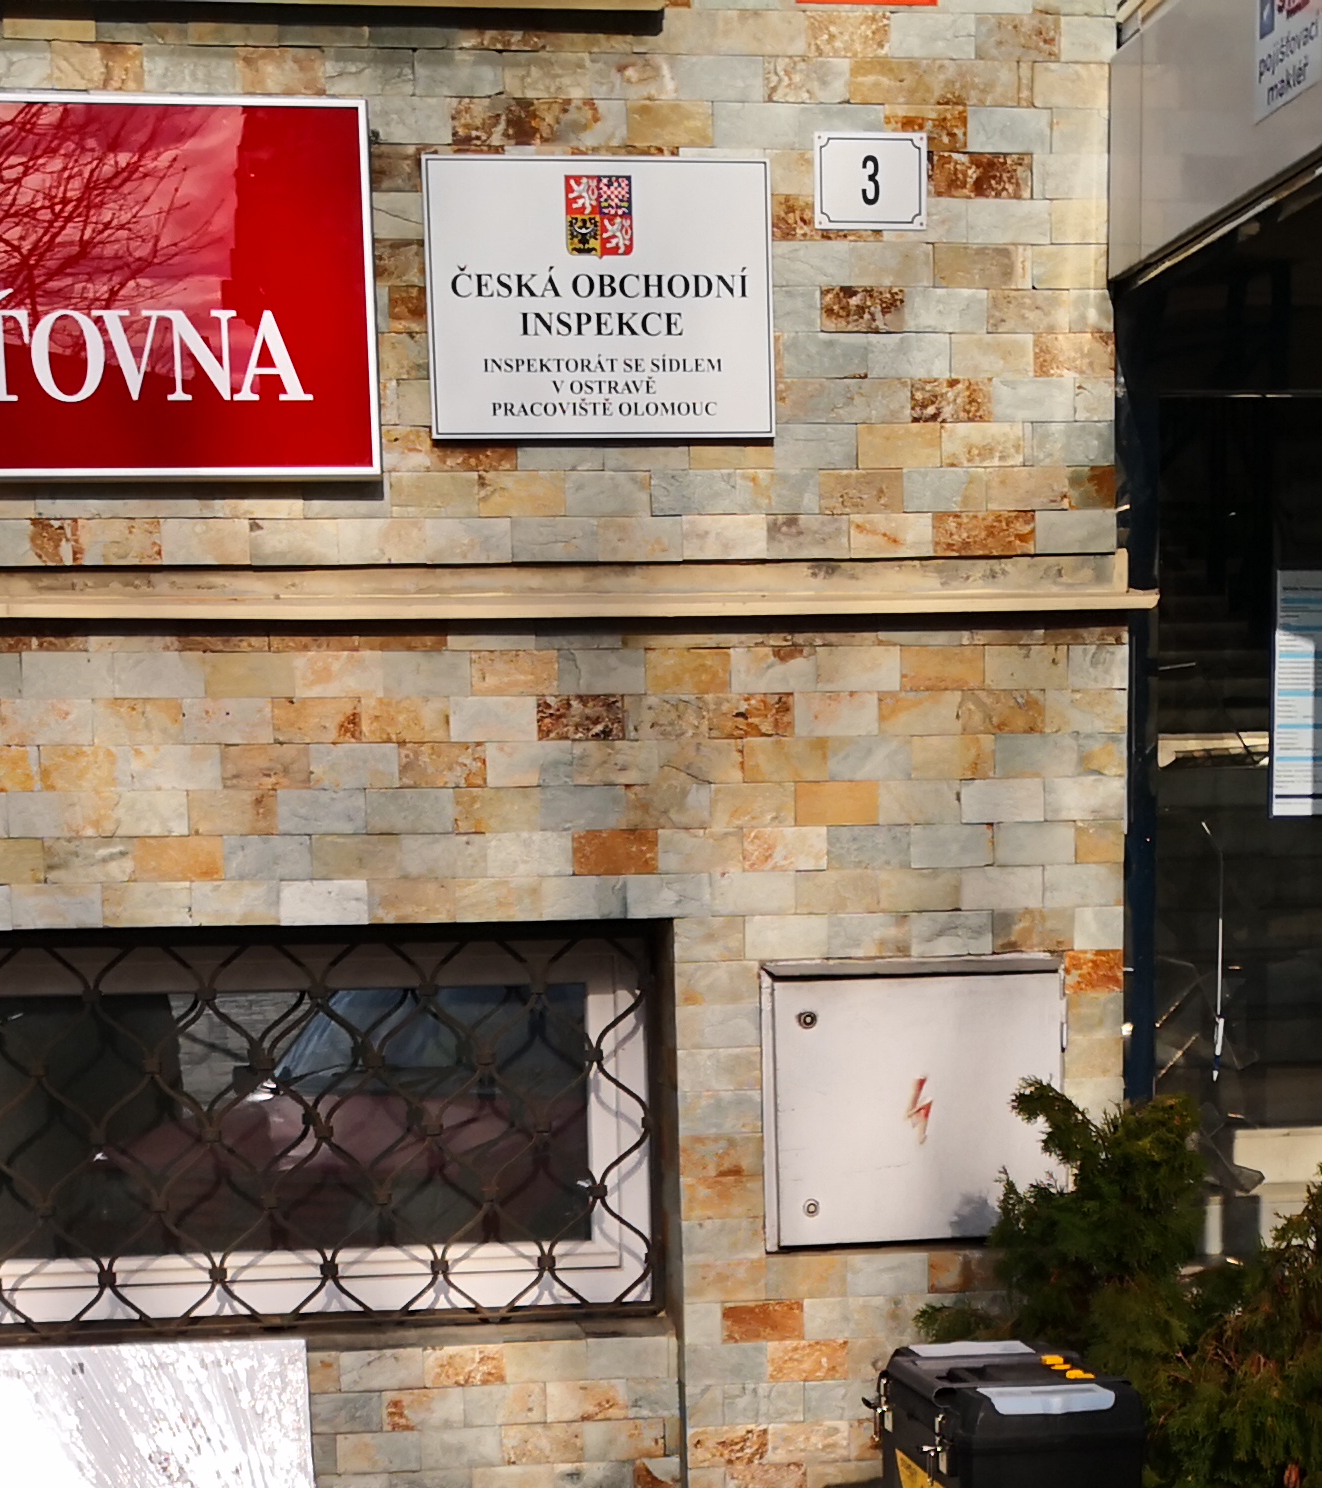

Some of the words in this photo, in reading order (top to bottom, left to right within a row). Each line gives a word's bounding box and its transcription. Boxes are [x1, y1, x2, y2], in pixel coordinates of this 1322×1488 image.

[861, 154, 881, 206] 3
[450, 265, 563, 299] ČESKÁ
[571, 266, 749, 299] OBCHODNÍ
[519, 312, 684, 338] INSPEKCE
[483, 354, 618, 373] INSPEKTORÁT
[623, 358, 645, 373] SE
[650, 354, 723, 373] SÍDLEM
[552, 380, 565, 395] V
[569, 376, 657, 395] OSTRAVĚ
[491, 398, 613, 417] PRACOVIŠTĚ
[618, 402, 718, 417] OLOMOUC
